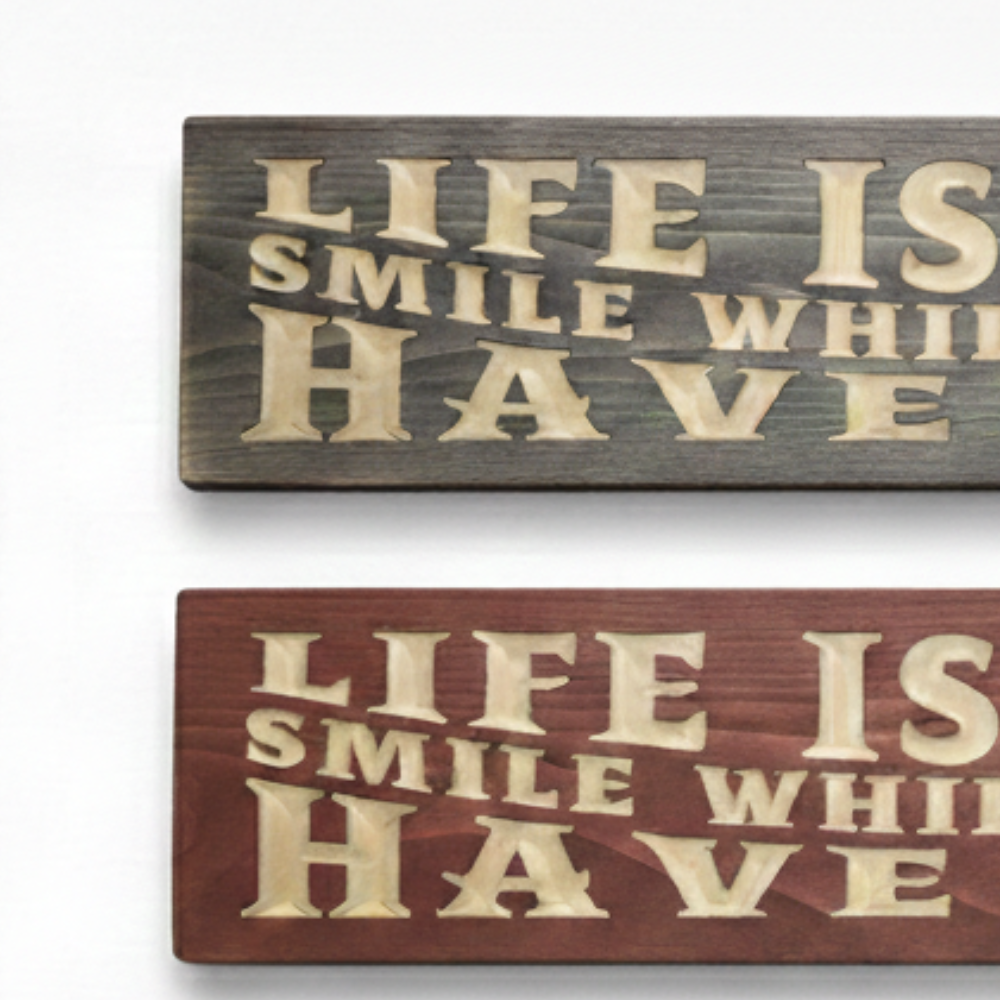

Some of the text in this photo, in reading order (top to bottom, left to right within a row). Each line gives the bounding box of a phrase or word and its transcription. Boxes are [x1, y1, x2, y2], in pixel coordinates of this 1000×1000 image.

[248, 235, 634, 342] SMILE
[254, 158, 707, 278] LIFE
[802, 159, 1000, 293] IS
[240, 304, 950, 443] HAVE
[245, 710, 634, 817] SMILE
[251, 631, 708, 752] LIFE
[801, 630, 1000, 766] IS
[241, 778, 952, 919] HAVE
